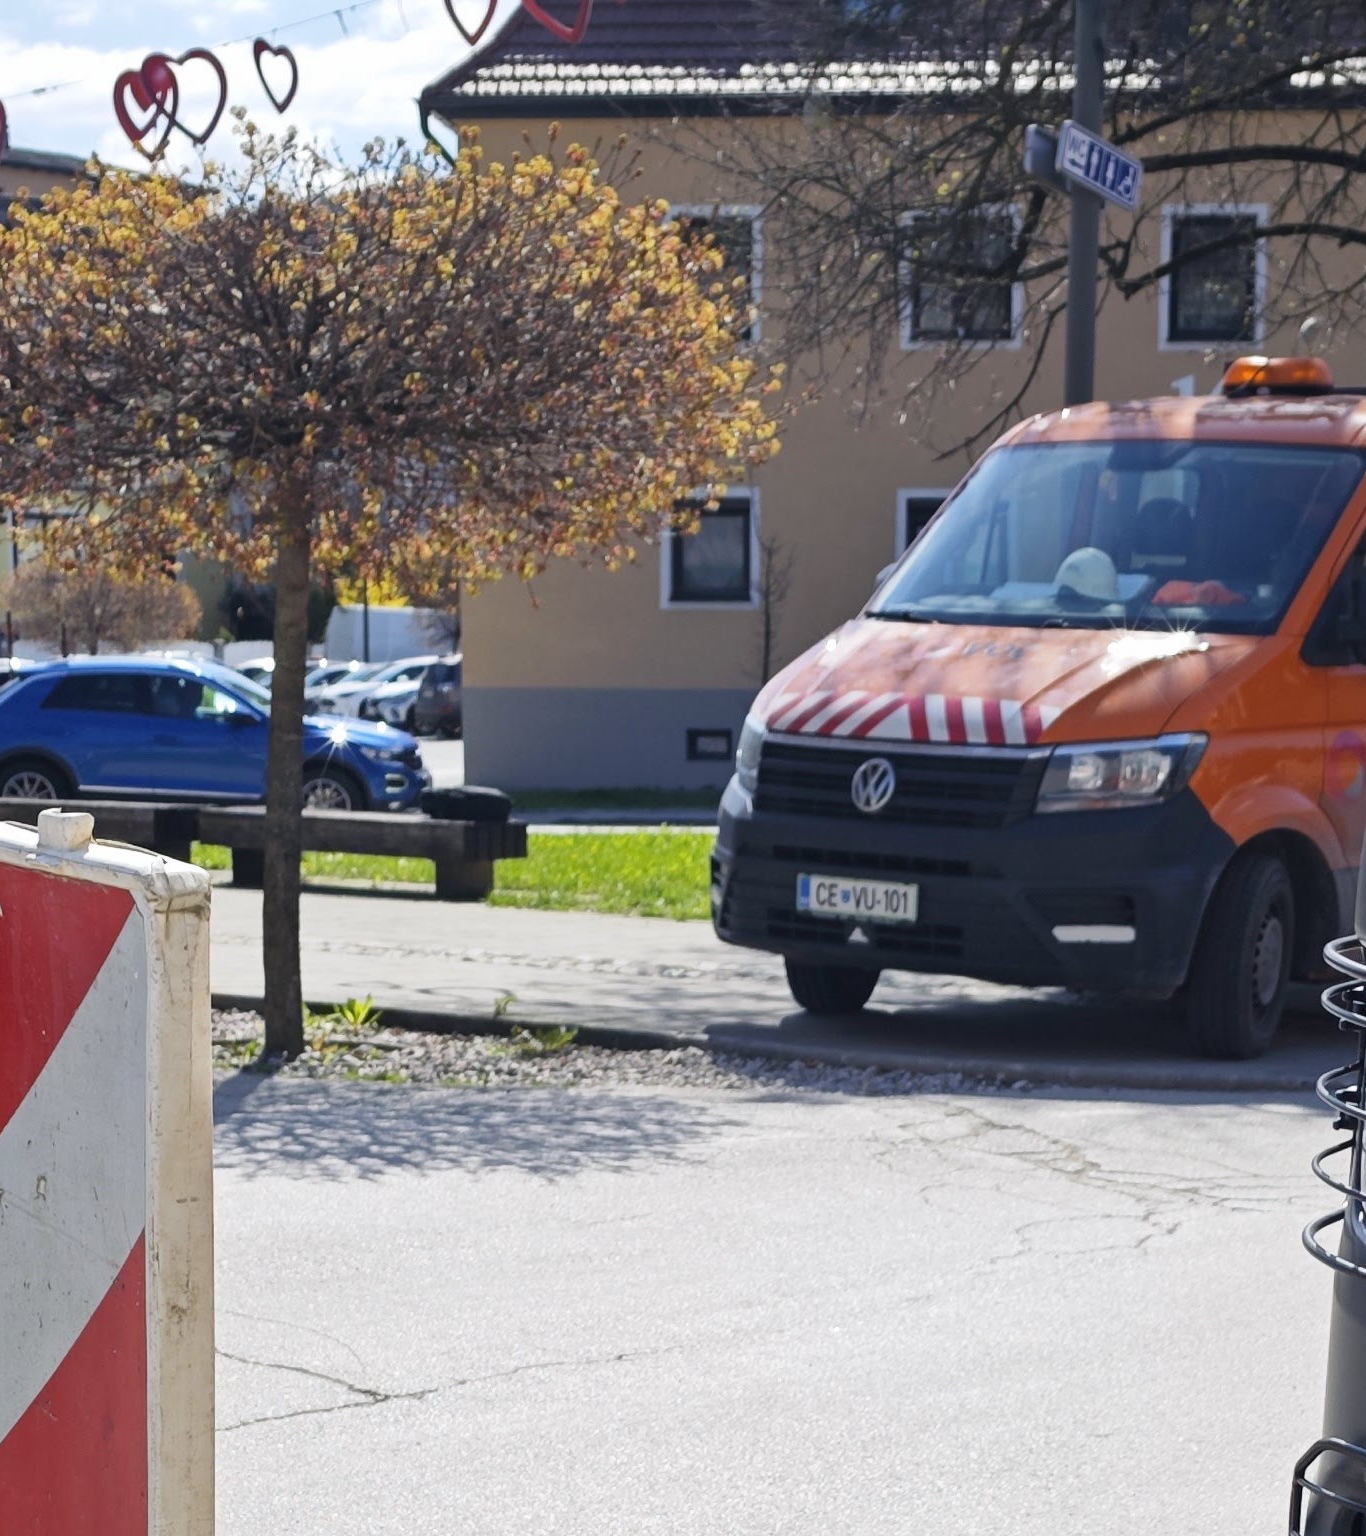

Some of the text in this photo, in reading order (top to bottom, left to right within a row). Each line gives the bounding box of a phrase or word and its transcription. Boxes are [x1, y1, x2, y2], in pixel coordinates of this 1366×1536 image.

[1068, 129, 1087, 158] WC
[815, 882, 838, 908] CE
[852, 886, 909, 914] VU-101
